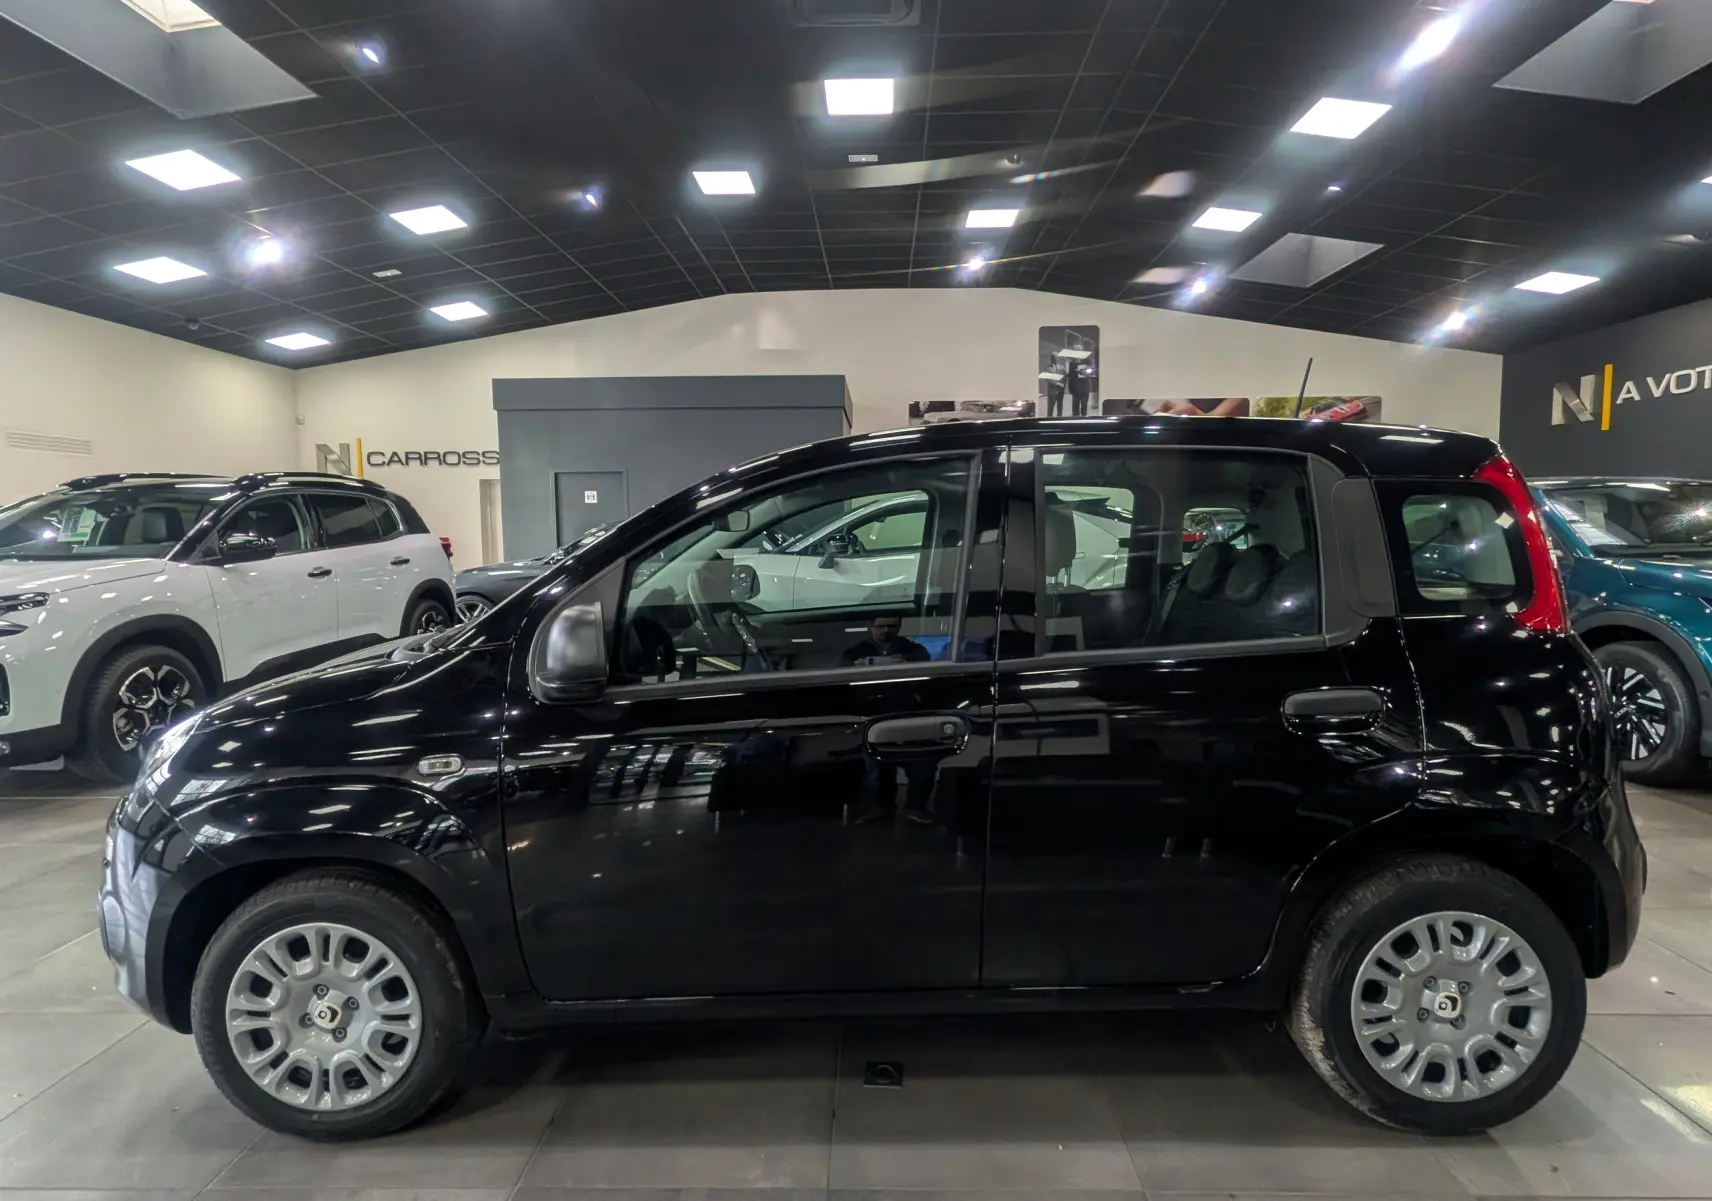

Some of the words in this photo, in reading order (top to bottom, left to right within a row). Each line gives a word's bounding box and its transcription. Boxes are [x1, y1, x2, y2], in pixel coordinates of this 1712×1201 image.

[1616, 381, 1641, 404] A
[1646, 365, 1712, 397] VOT
[366, 450, 500, 467] CARROSS
